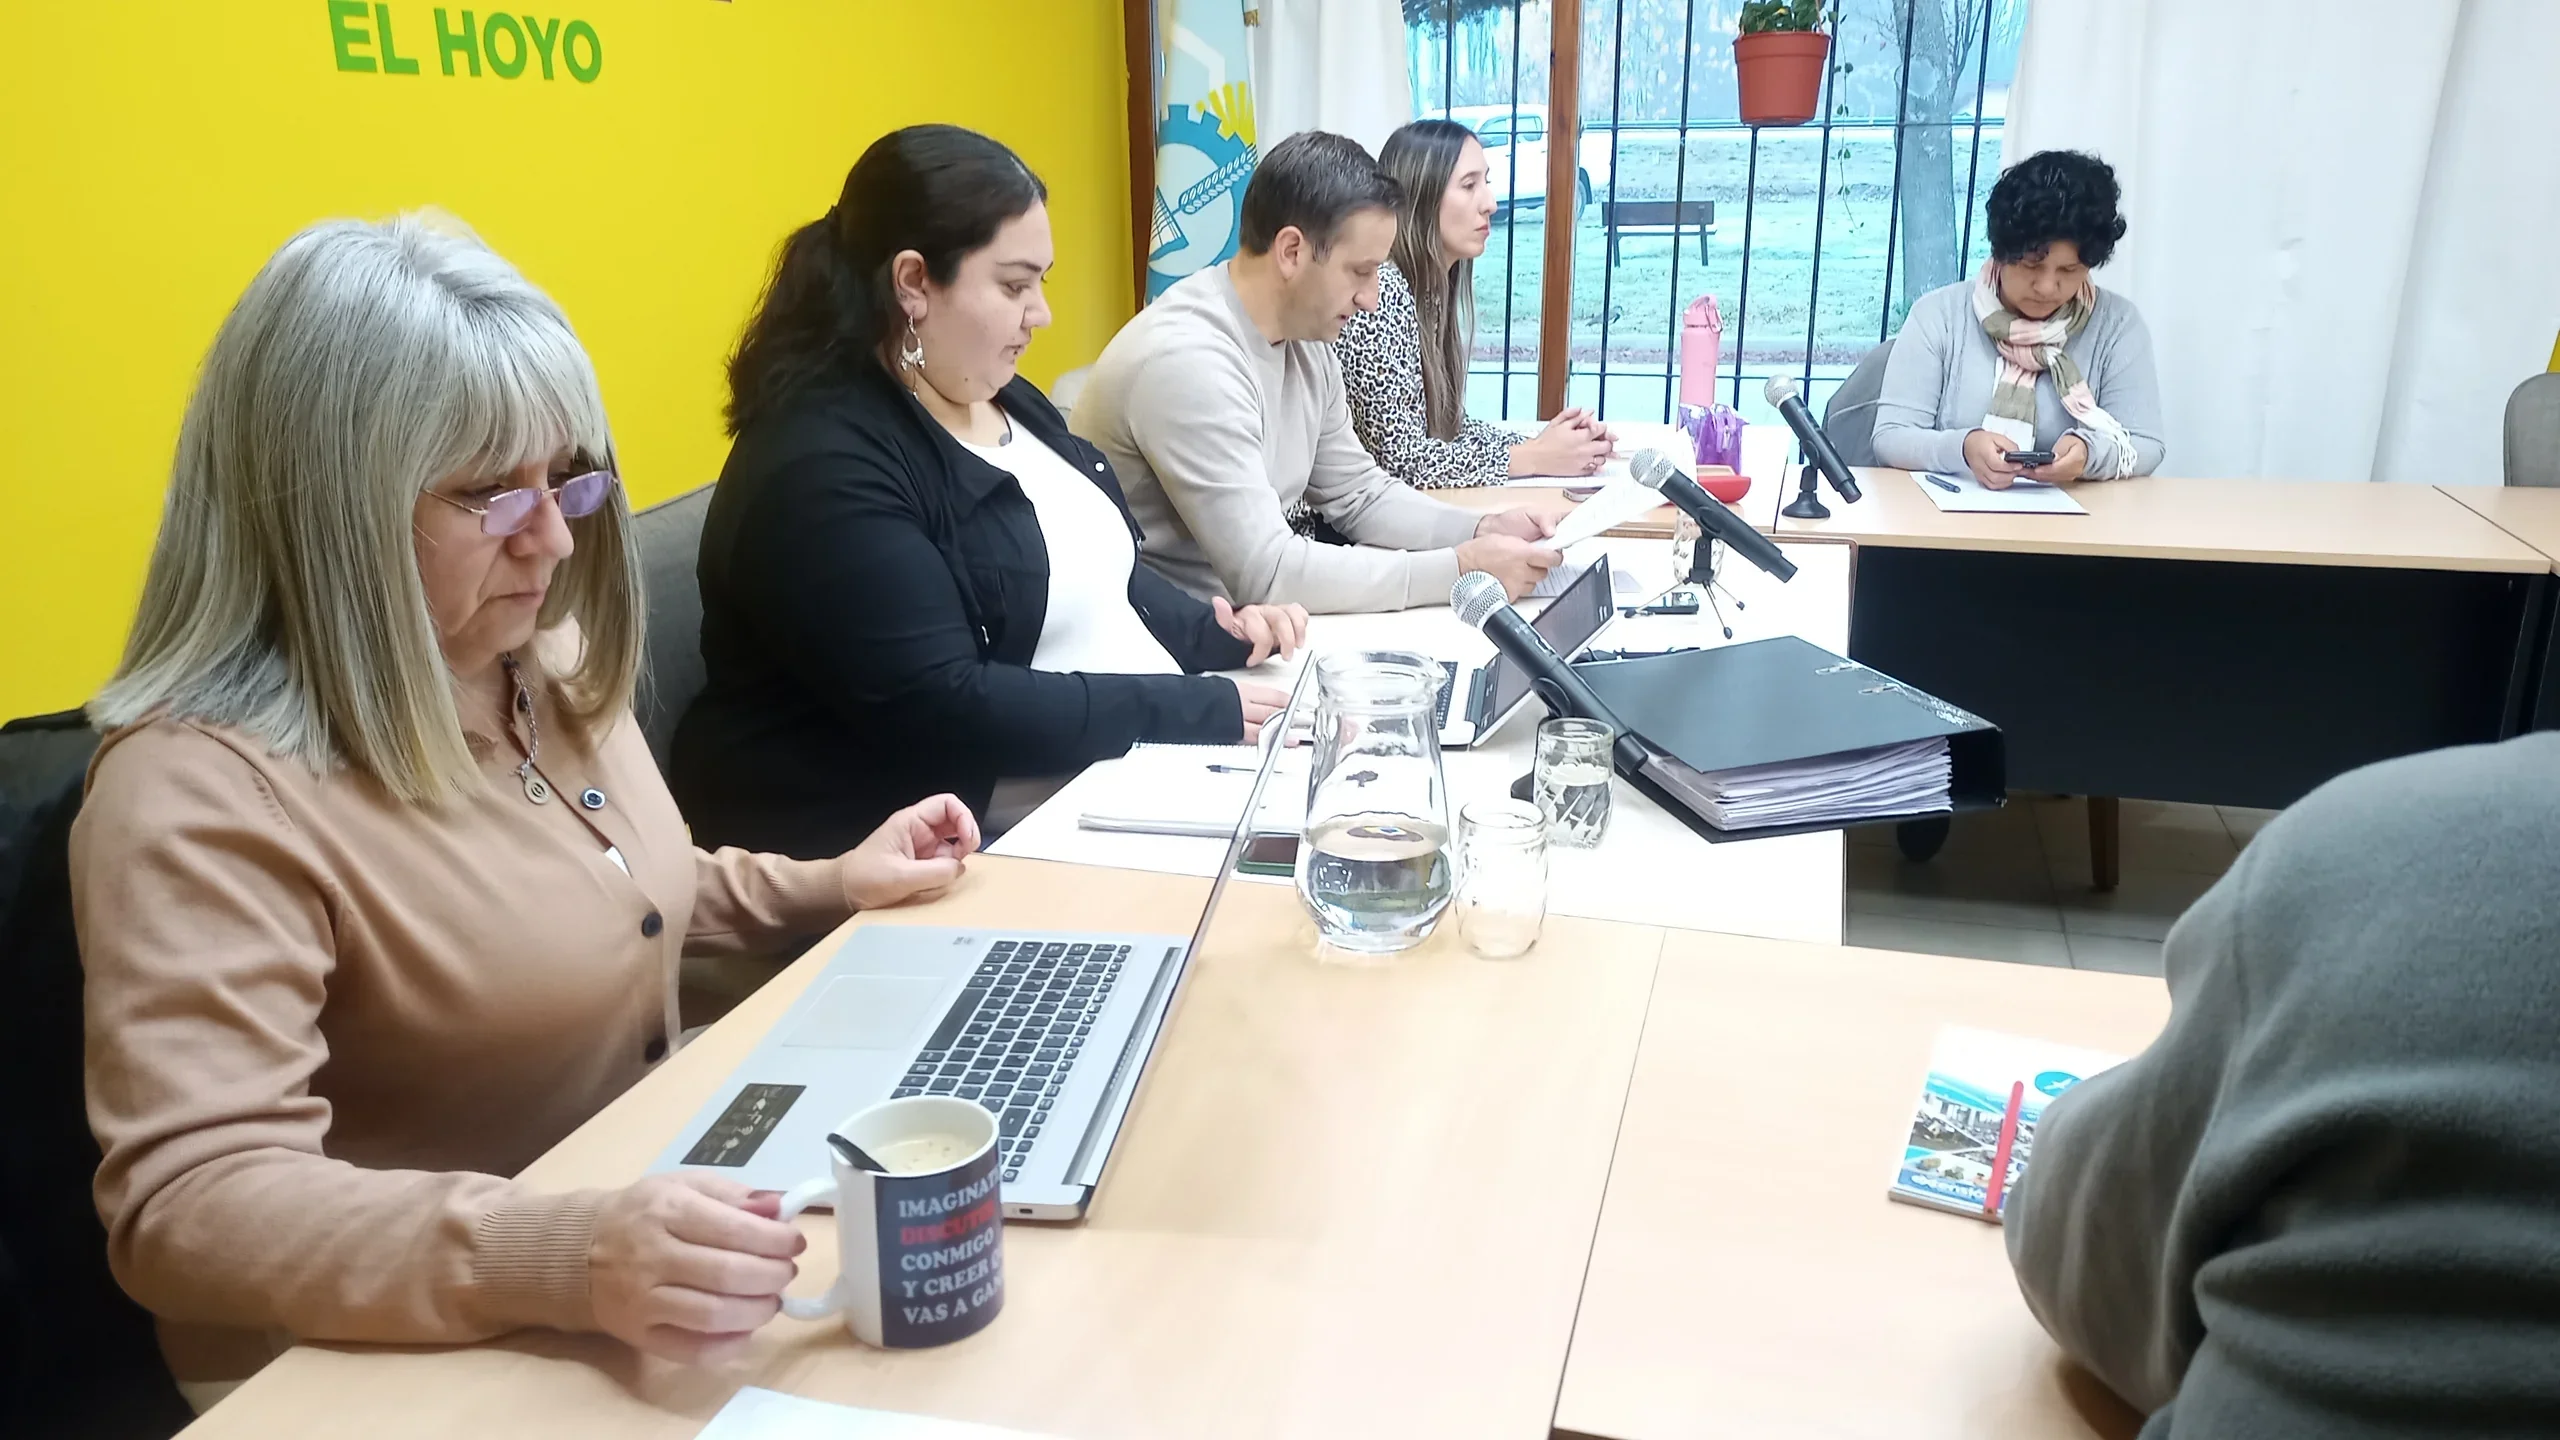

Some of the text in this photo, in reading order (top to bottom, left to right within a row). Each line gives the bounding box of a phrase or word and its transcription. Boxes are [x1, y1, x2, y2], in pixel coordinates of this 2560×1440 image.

[327, 0, 602, 83] EL HOYO
[901, 1226, 994, 1271] CONMIGO
[902, 1280, 919, 1298] Y
[924, 1258, 989, 1296] CREER
[903, 1303, 948, 1325] VAS
[953, 1297, 968, 1317] A
